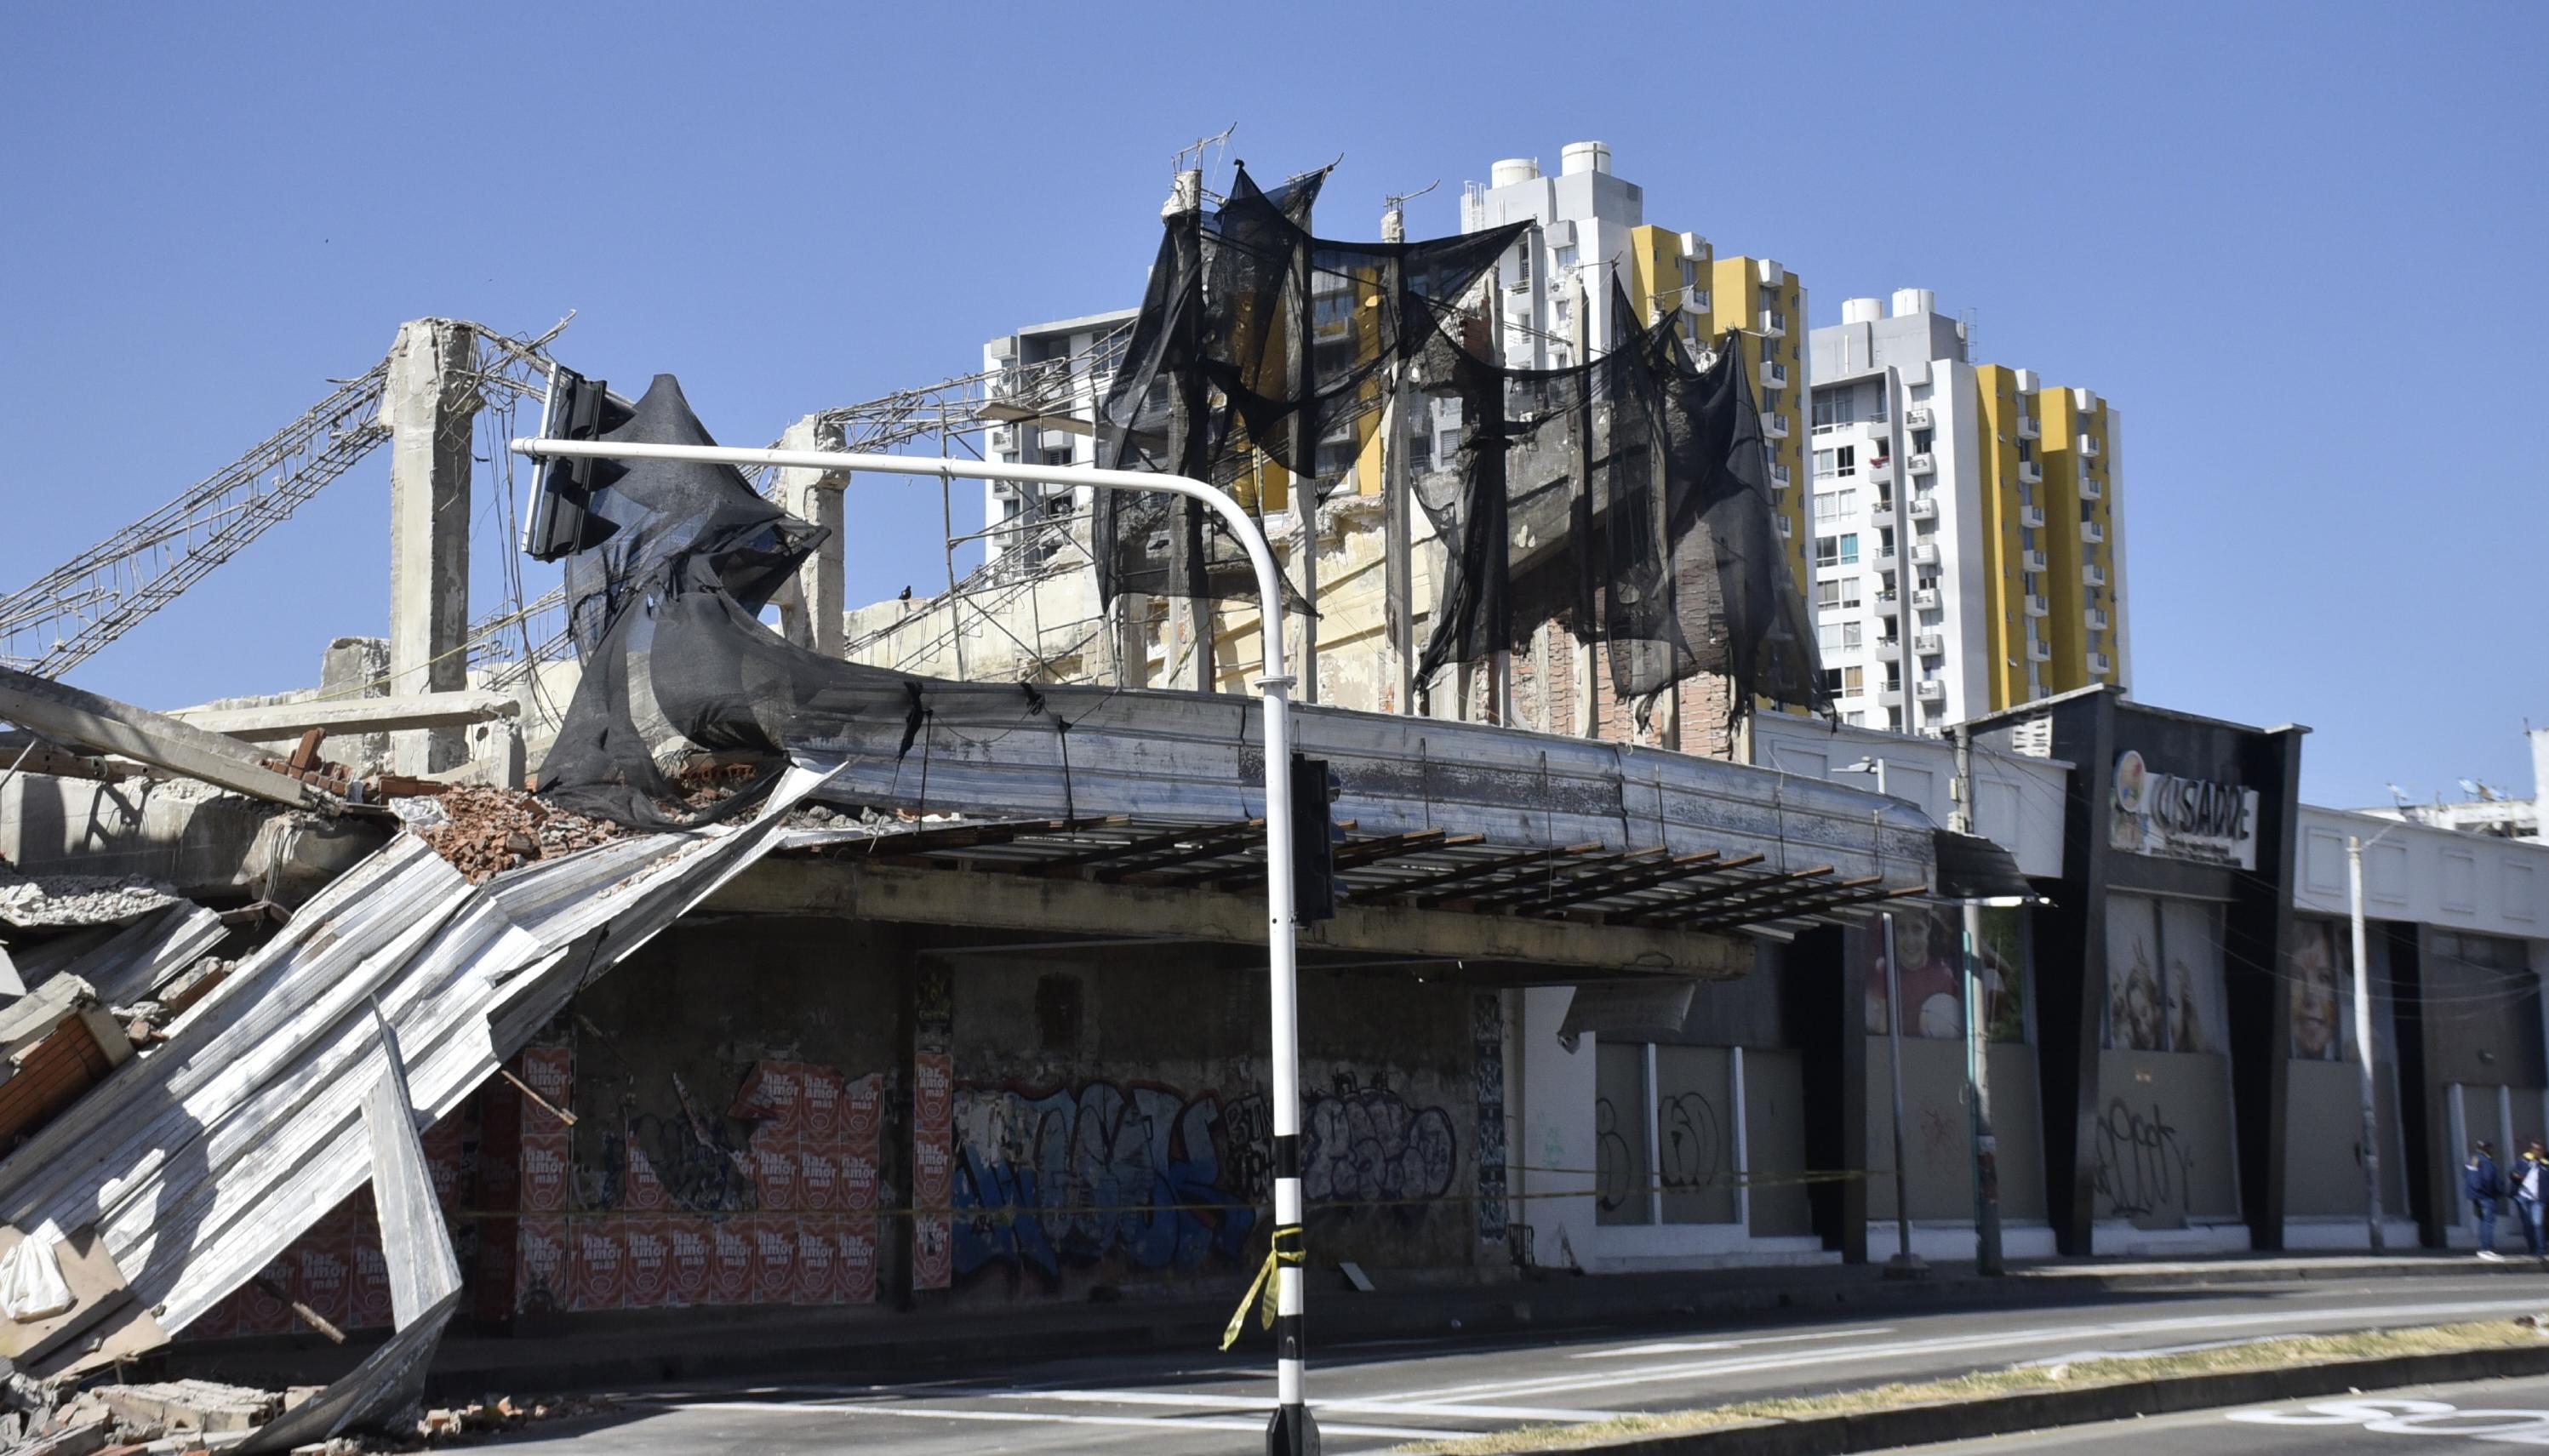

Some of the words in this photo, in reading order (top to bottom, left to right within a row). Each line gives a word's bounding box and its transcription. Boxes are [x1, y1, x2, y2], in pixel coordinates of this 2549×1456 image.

[528, 1059, 558, 1074] haz
[918, 1066, 940, 1077] haz
[530, 1074, 567, 1085] amor
[763, 1071, 789, 1085] haz
[804, 1073, 830, 1088] haz
[919, 1077, 949, 1088] amor
[805, 1088, 839, 1099] amor
[917, 1140, 939, 1154] haz
[526, 1147, 553, 1161] haz
[761, 1152, 786, 1164] haz
[803, 1152, 827, 1168] haz
[918, 1154, 948, 1165] amor
[527, 1162, 565, 1173] amor
[842, 1154, 866, 1168] haz
[762, 1163, 797, 1175] amor
[803, 1167, 837, 1178] amor
[842, 1168, 877, 1178] amor
[583, 1234, 613, 1249] haz
[629, 1231, 656, 1246] haz
[673, 1230, 700, 1245] haz
[716, 1231, 742, 1246] haz
[757, 1230, 783, 1245] haz
[799, 1233, 823, 1247] haz
[839, 1232, 864, 1247] haz
[357, 1246, 382, 1263] ha
[584, 1248, 623, 1261] amor
[631, 1246, 668, 1258] amor
[674, 1245, 711, 1256] amor
[716, 1245, 753, 1256] amor
[758, 1245, 794, 1256] amor
[799, 1247, 834, 1257] amor
[840, 1247, 875, 1257] amor
[302, 1251, 334, 1266] haz
[303, 1265, 348, 1280] amor
